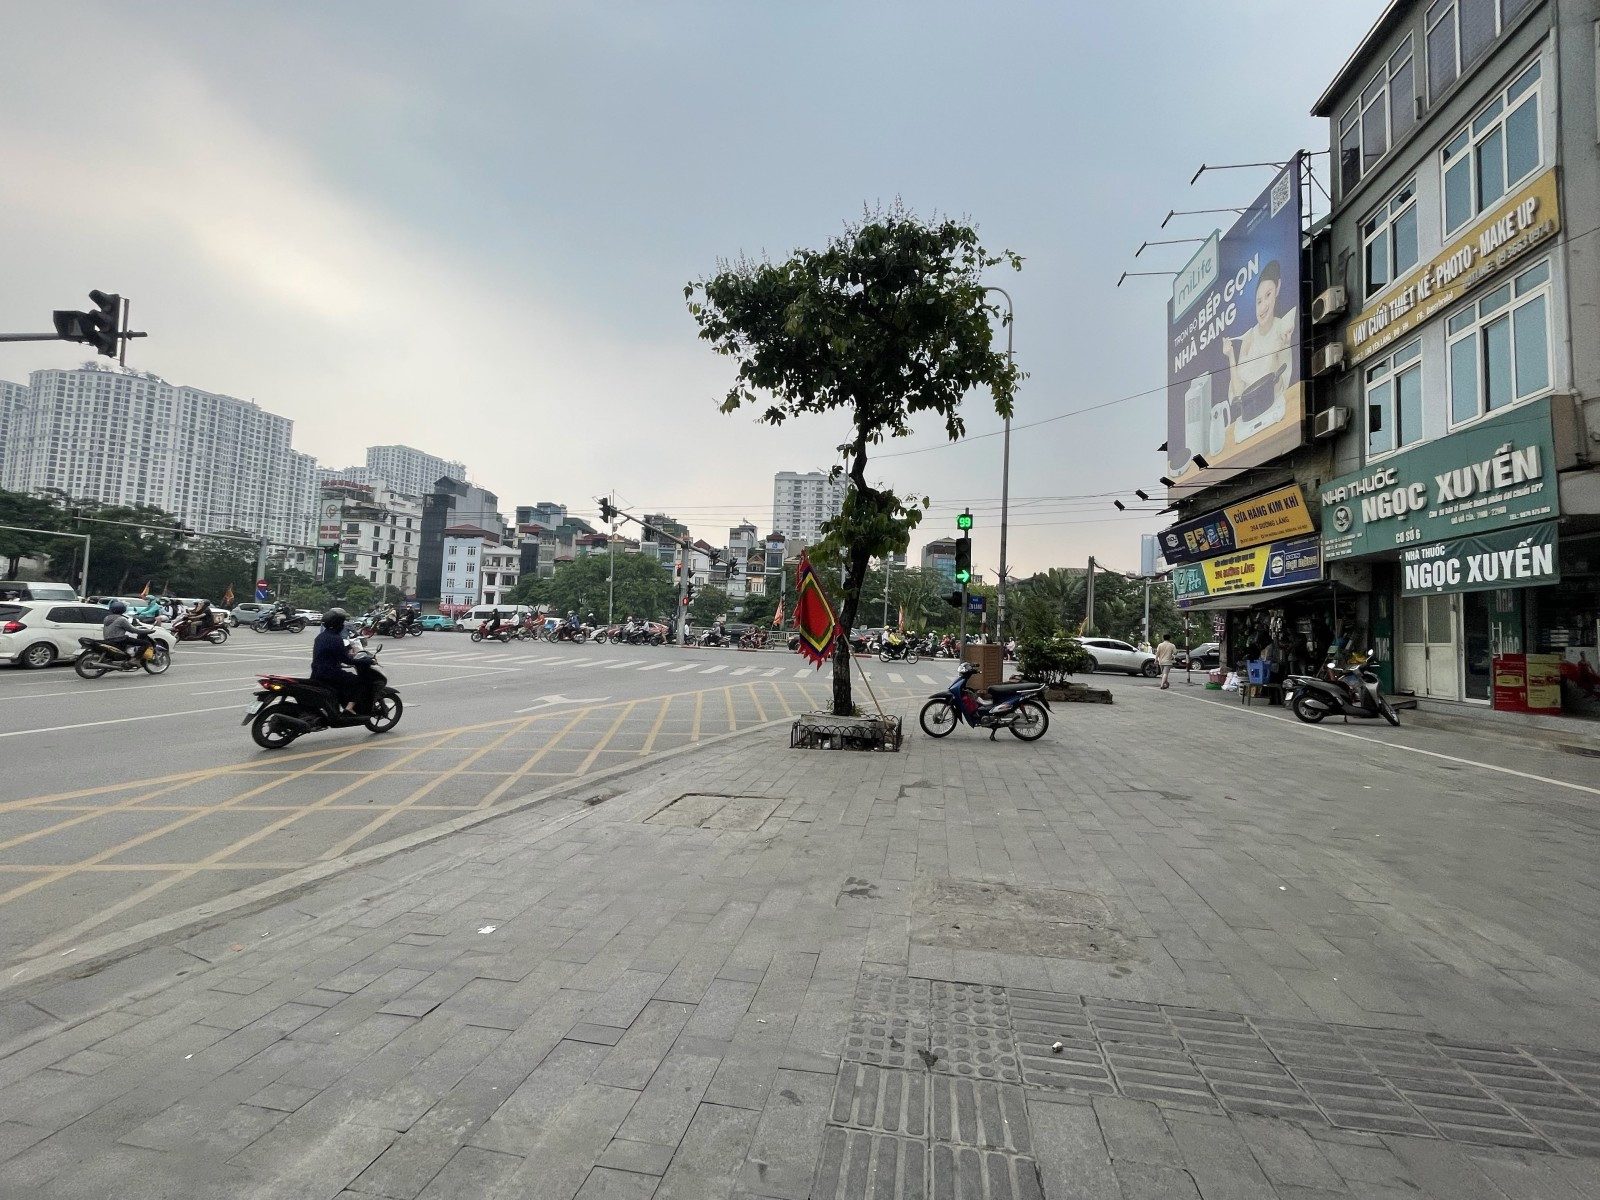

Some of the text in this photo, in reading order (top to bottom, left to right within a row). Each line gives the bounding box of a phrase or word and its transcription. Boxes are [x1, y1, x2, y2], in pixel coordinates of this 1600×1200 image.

[1436, 245, 1472, 288] PHOTO
[1480, 210, 1516, 258] MAKE
[1517, 196, 1536, 230] UP
[1178, 258, 1212, 305] miLife
[1224, 252, 1258, 302] GỌN
[1174, 302, 1236, 374] NHÀ SANG
[960, 516, 971, 528] 99
[1247, 506, 1268, 520] HÀNG
[1268, 500, 1284, 514] KIM
[1362, 482, 1426, 524] NGỌC
[1405, 543, 1445, 561] NHÀ THUỐC
[1406, 538, 1553, 591] NGỌC XUYẾN
